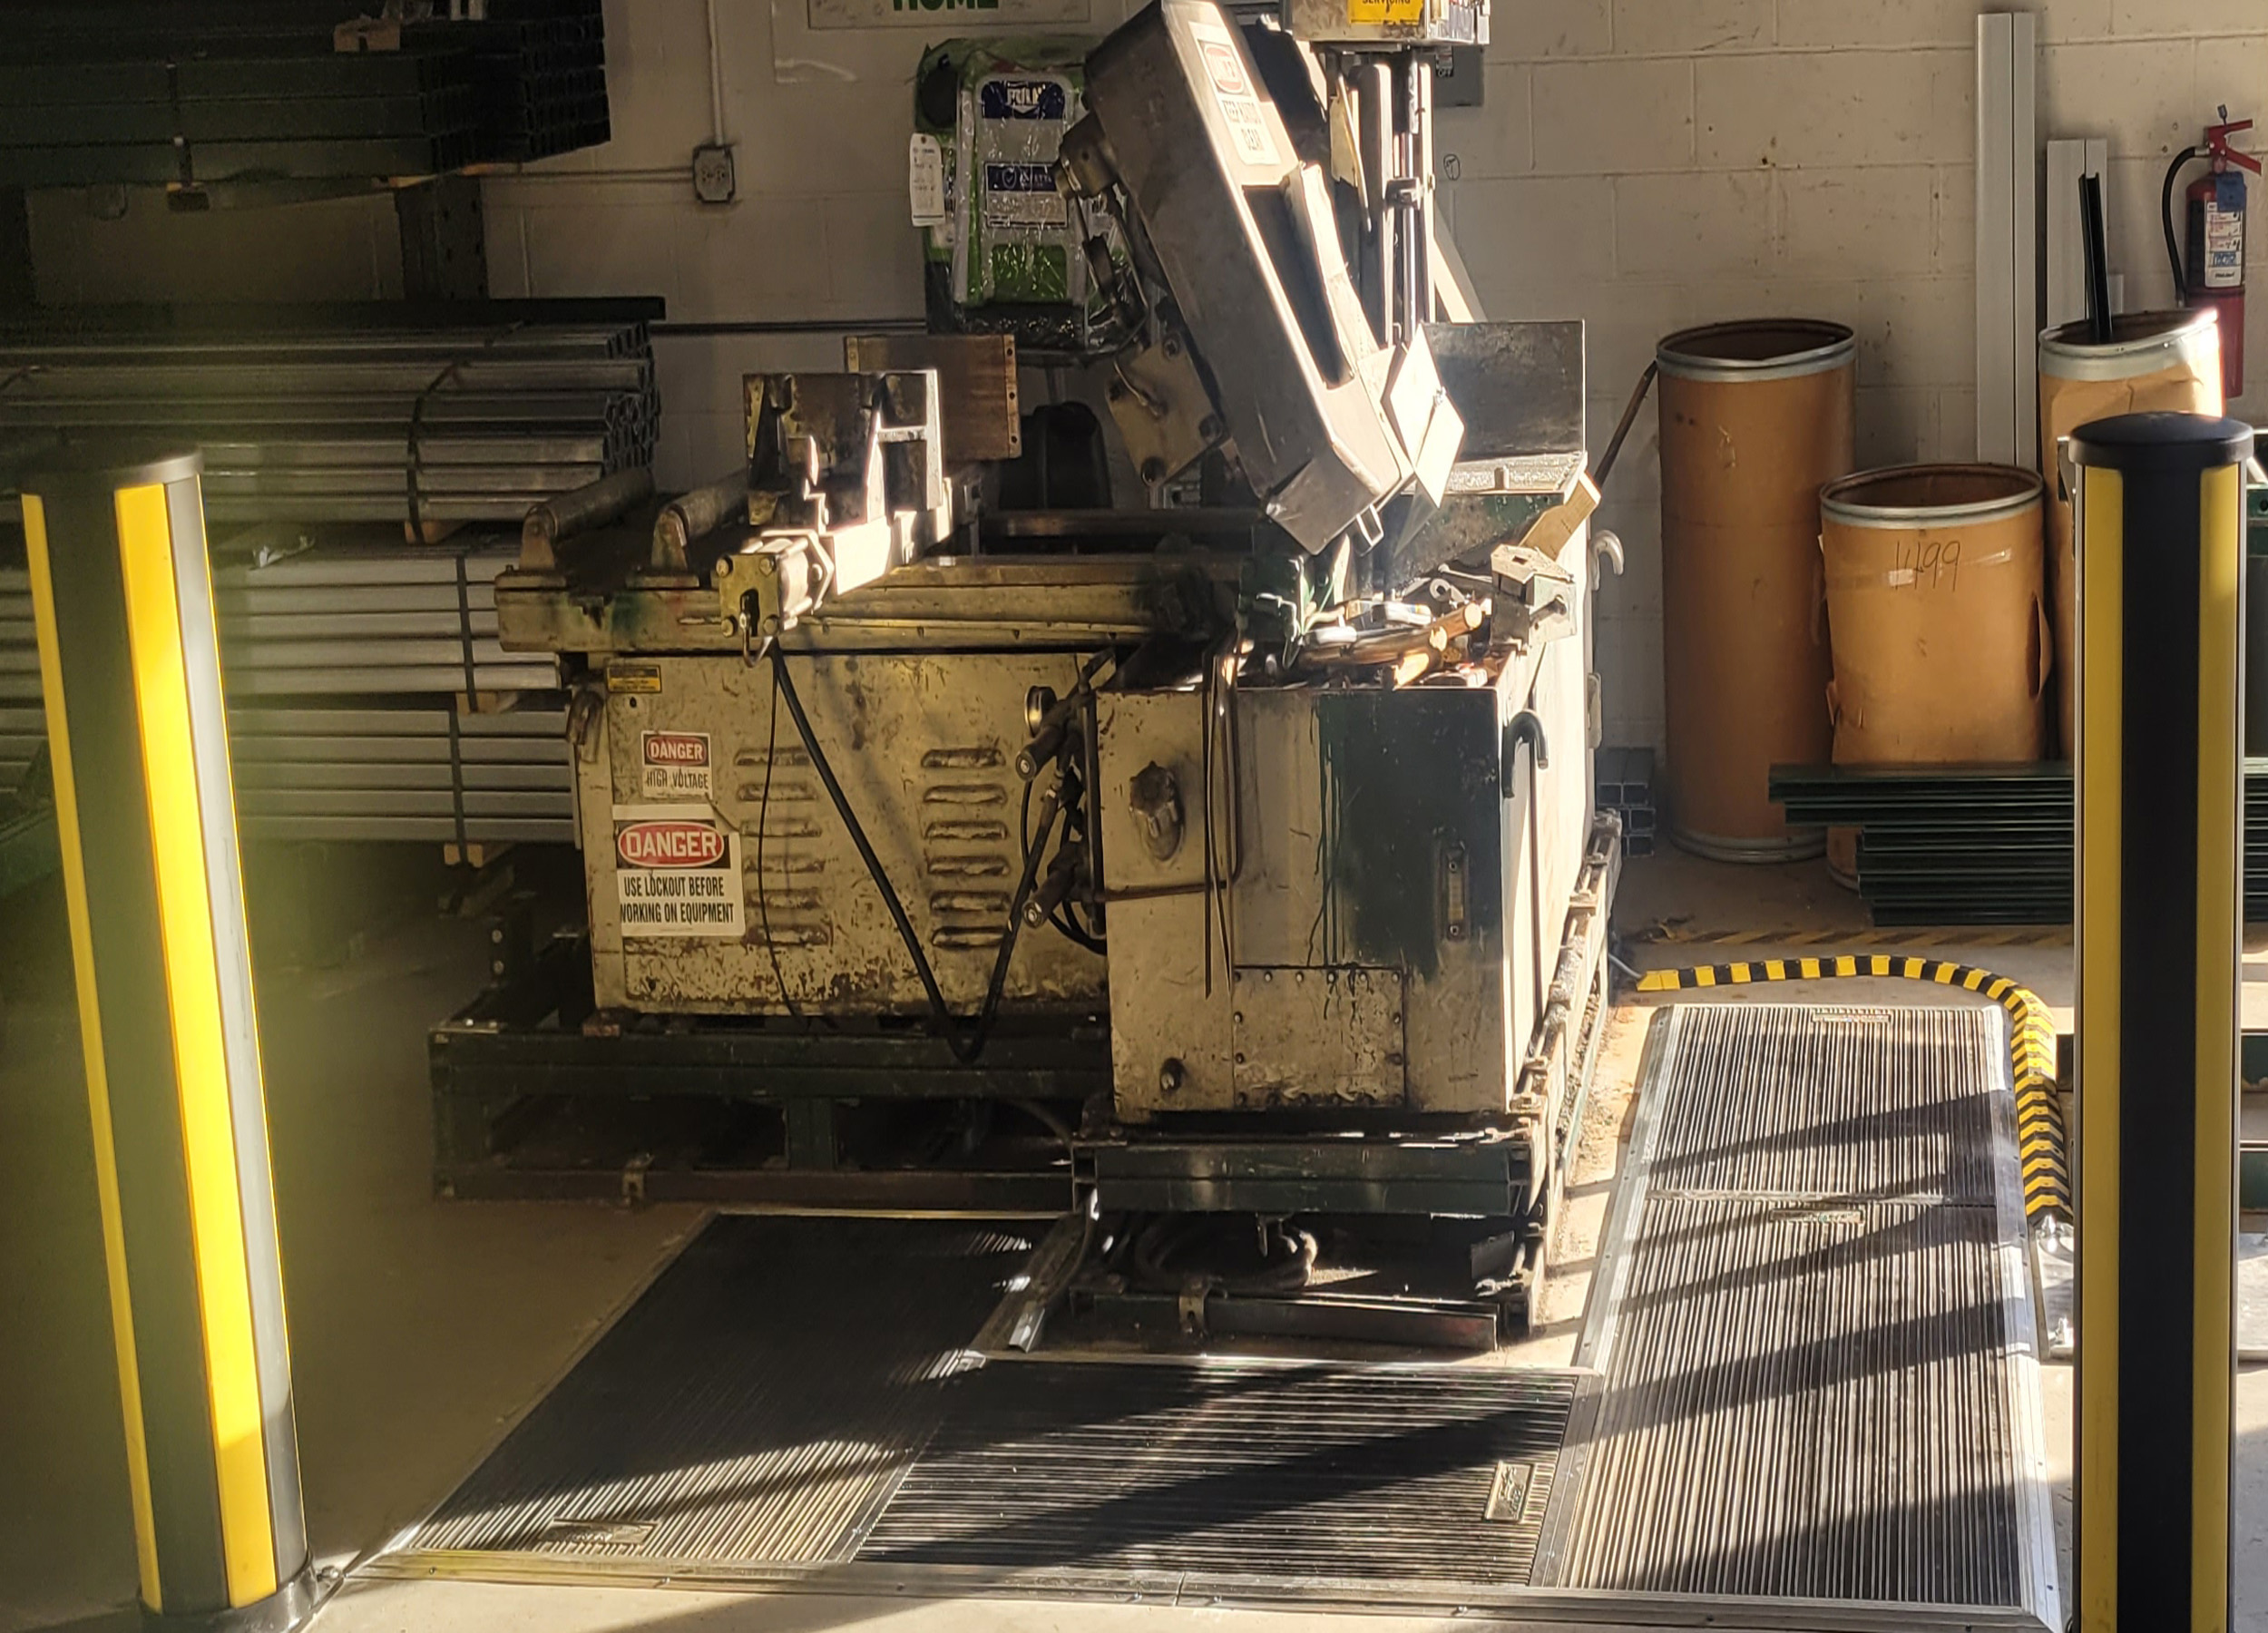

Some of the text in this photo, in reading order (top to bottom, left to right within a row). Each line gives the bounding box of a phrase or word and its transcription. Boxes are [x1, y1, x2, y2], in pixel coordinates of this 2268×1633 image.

[650, 741, 703, 760] DANGER
[647, 770, 709, 789] HIGH VOLTAGE
[626, 831, 717, 857] DANGER
[624, 876, 724, 896] USE LOCKOUT BEFORE
[664, 903, 678, 923] ON
[680, 903, 734, 924] EQUIPMENT
